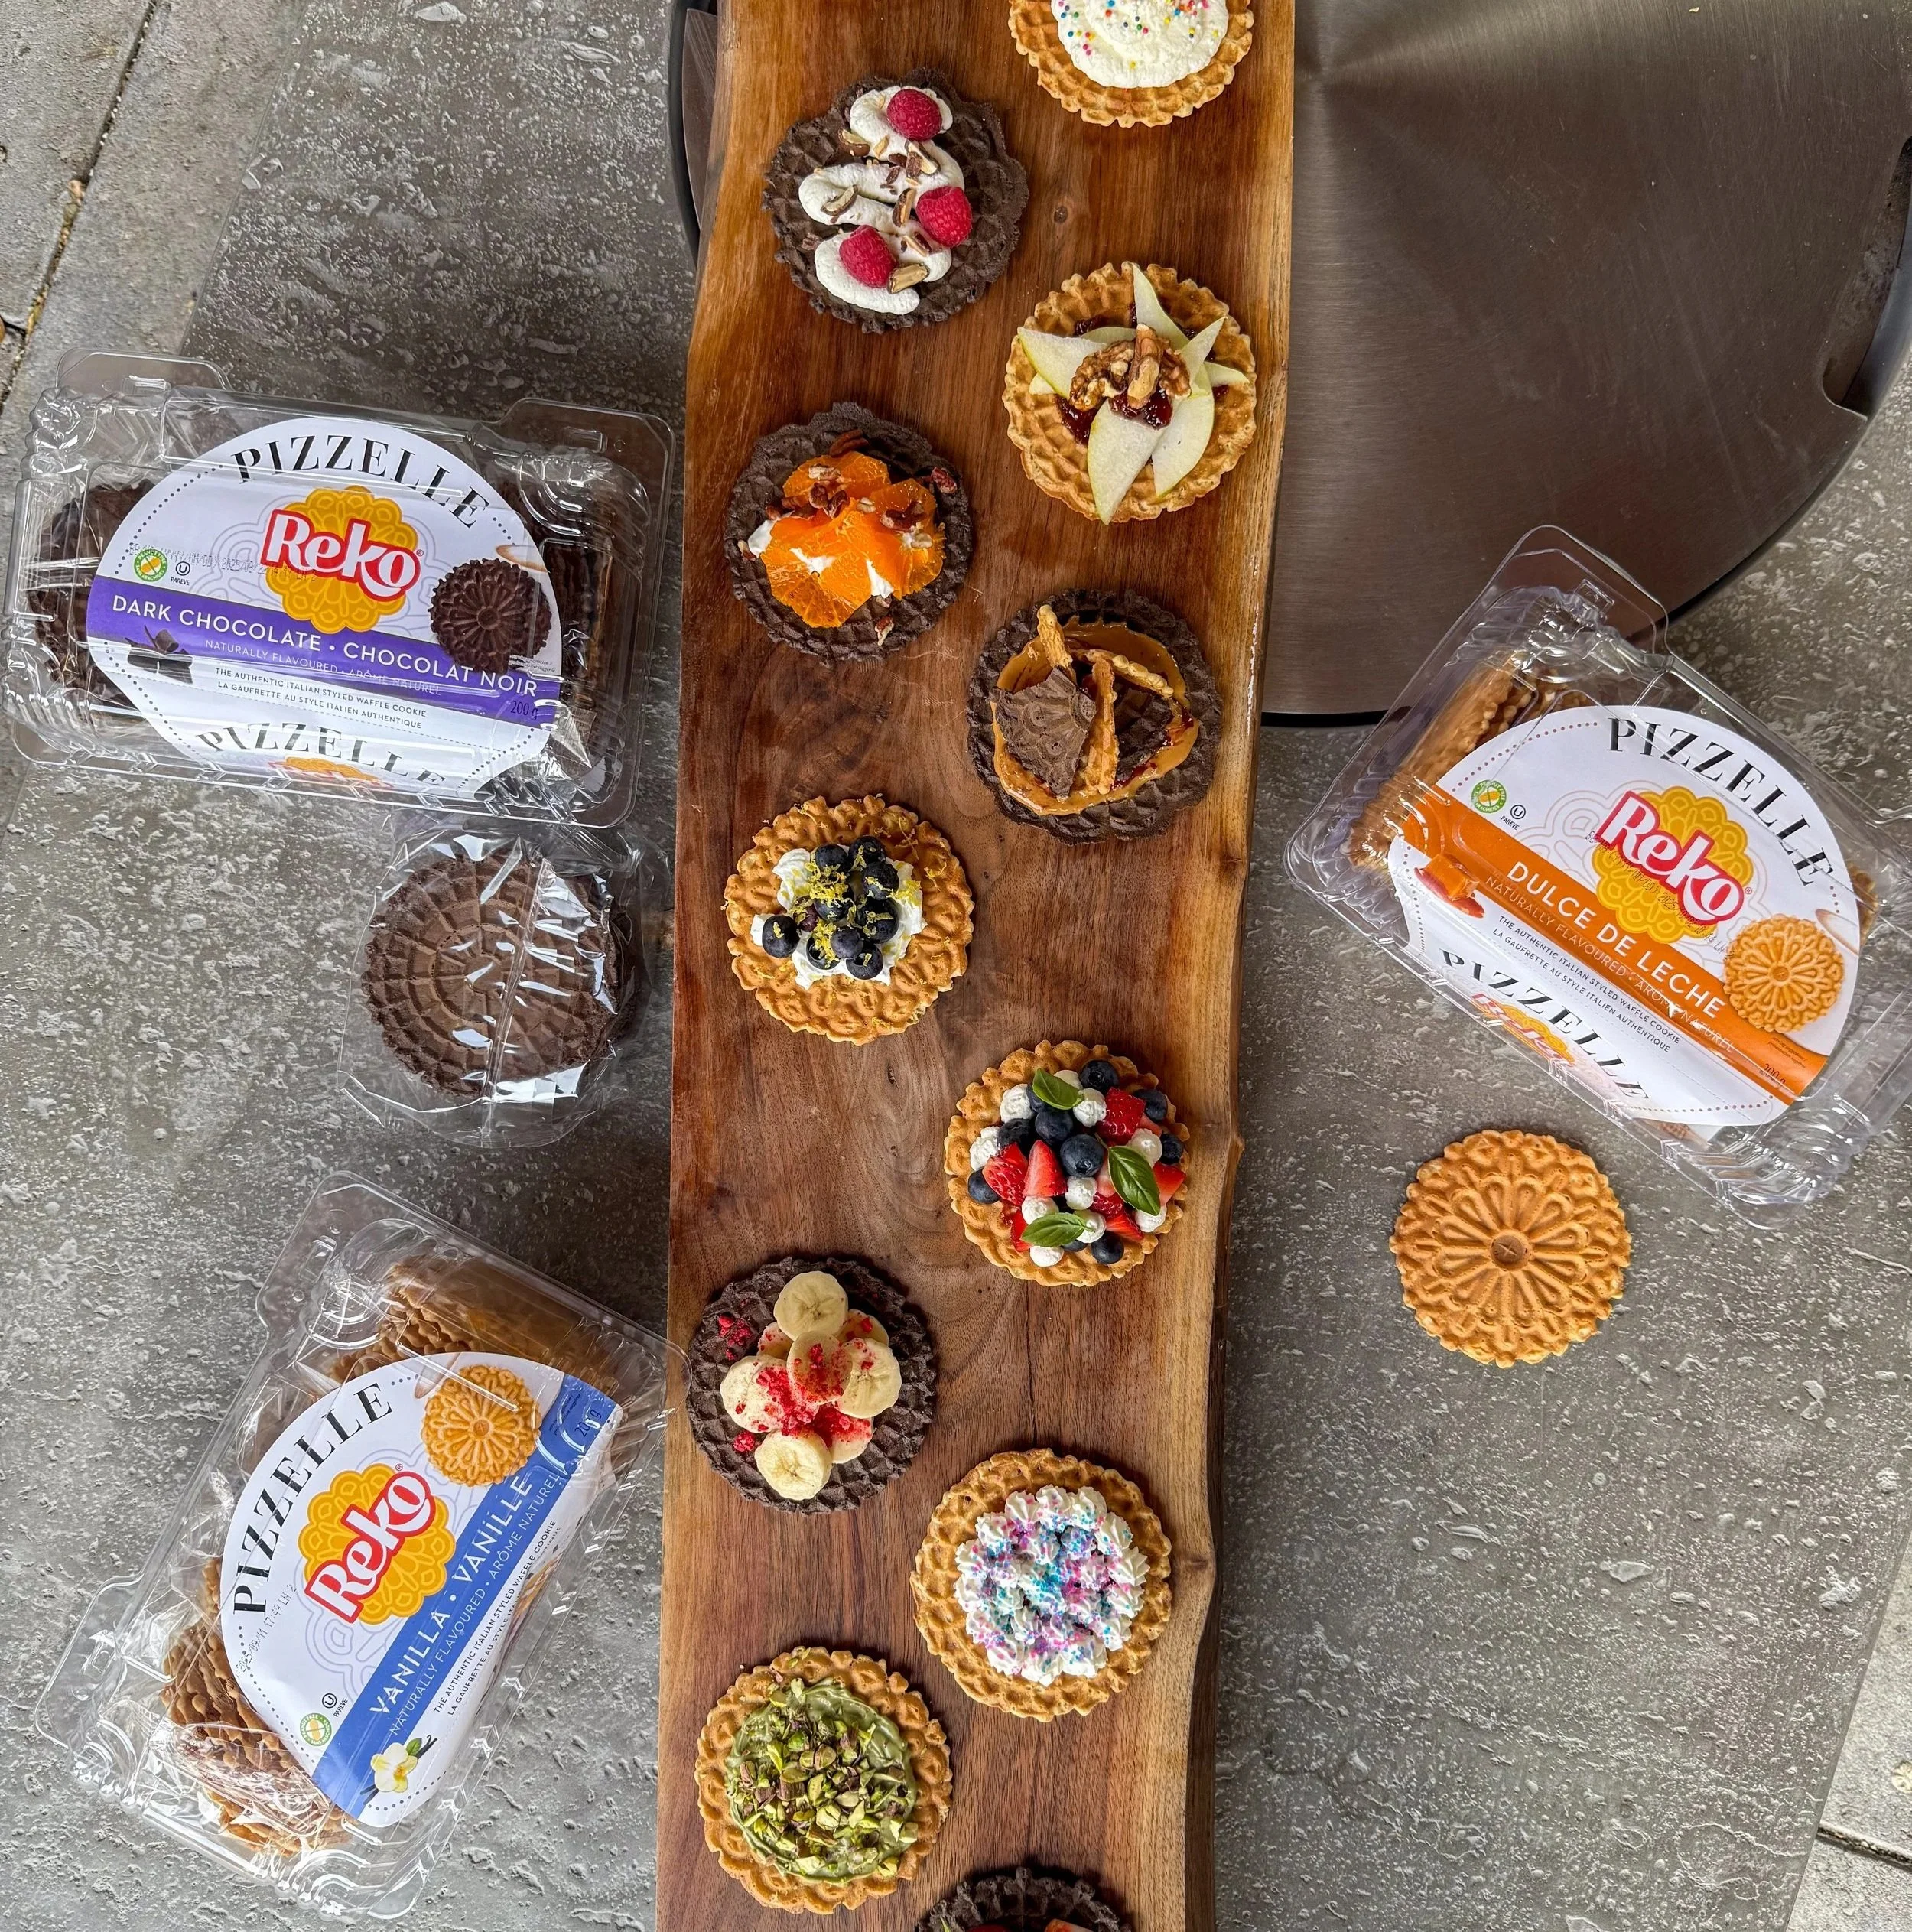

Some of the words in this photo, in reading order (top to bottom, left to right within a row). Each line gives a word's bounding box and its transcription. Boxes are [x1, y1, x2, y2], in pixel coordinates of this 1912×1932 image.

[231, 434, 490, 529] PIZZELLE
[171, 577, 190, 586] PAREVE
[262, 510, 421, 600] Reko
[112, 595, 172, 622] DARK
[179, 609, 321, 652] CHOCOLATE
[344, 642, 473, 683] CHOCOLAT
[480, 672, 537, 698] NOIR
[206, 639, 268, 659] NATURALLY
[272, 652, 337, 673] FLAVOURED
[215, 667, 232, 678] THE
[287, 681, 320, 694] ITALIAN
[322, 688, 353, 702] STYLED
[356, 696, 390, 710] WAFFLE
[392, 704, 427, 718] COOKIE
[195, 723, 446, 786] PIZZELLE
[218, 681, 229, 690] LA
[231, 684, 281, 700] GAUFRETTE
[285, 694, 296, 702] AU
[299, 697, 324, 708] STYLE
[327, 702, 359, 715] ITALIEN
[361, 710, 422, 730] AUTHENTIQUE
[511, 700, 529, 716] 200
[1501, 815, 1520, 831] PAREVE
[1606, 717, 1834, 886] PIZZELLE
[1598, 792, 1741, 923] Reko
[1486, 876, 1554, 926] NATURALLY
[1555, 923, 1626, 977] FLAVOURED
[1507, 861, 1597, 929] DULCE
[1597, 922, 1637, 956] DE
[1637, 950, 1726, 1019] LECHE
[1439, 948, 1649, 1099] PIZZELLE
[1493, 928, 1504, 939] LA
[1504, 935, 1549, 970] GAUFRETTE
[1549, 964, 1561, 977] AU
[1562, 974, 1585, 994] STYLE
[1586, 993, 1616, 1016] ITALIEN
[1616, 1013, 1671, 1052] AUTHENTIQUE
[1498, 915, 1516, 929] THE
[1515, 925, 1559, 960] AUTHENTIC
[1559, 955, 1589, 980] ITALIAN
[1589, 977, 1619, 1001] STYLED
[1620, 999, 1649, 1023] WAFFLE
[1650, 1019, 1681, 1044] COOKIE
[233, 1382, 393, 1615] PIZZELLE
[307, 1472, 434, 1620] Reko
[264, 1605, 282, 1628] 17:49
[286, 1583, 297, 1593] 2
[370, 1609, 451, 1714] VANILLA
[451, 1474, 532, 1584] VANILLE
[389, 1664, 438, 1736] NATURALLY
[437, 1588, 486, 1663] FLAVOURED
[489, 1532, 522, 1579] ARÔME
[518, 1474, 561, 1531] NATUREL
[434, 1702, 447, 1714] THE
[446, 1651, 476, 1701] AUTHENTIC
[474, 1618, 495, 1651] ITALIAN
[494, 1588, 515, 1618] STYLED
[534, 1520, 556, 1553] COOKIE
[333, 1698, 348, 1718] PAREVE
[448, 1706, 458, 1716] LA
[456, 1660, 486, 1706] GAUFRETTE
[485, 1643, 494, 1655] AU
[493, 1618, 509, 1642] STYLE
